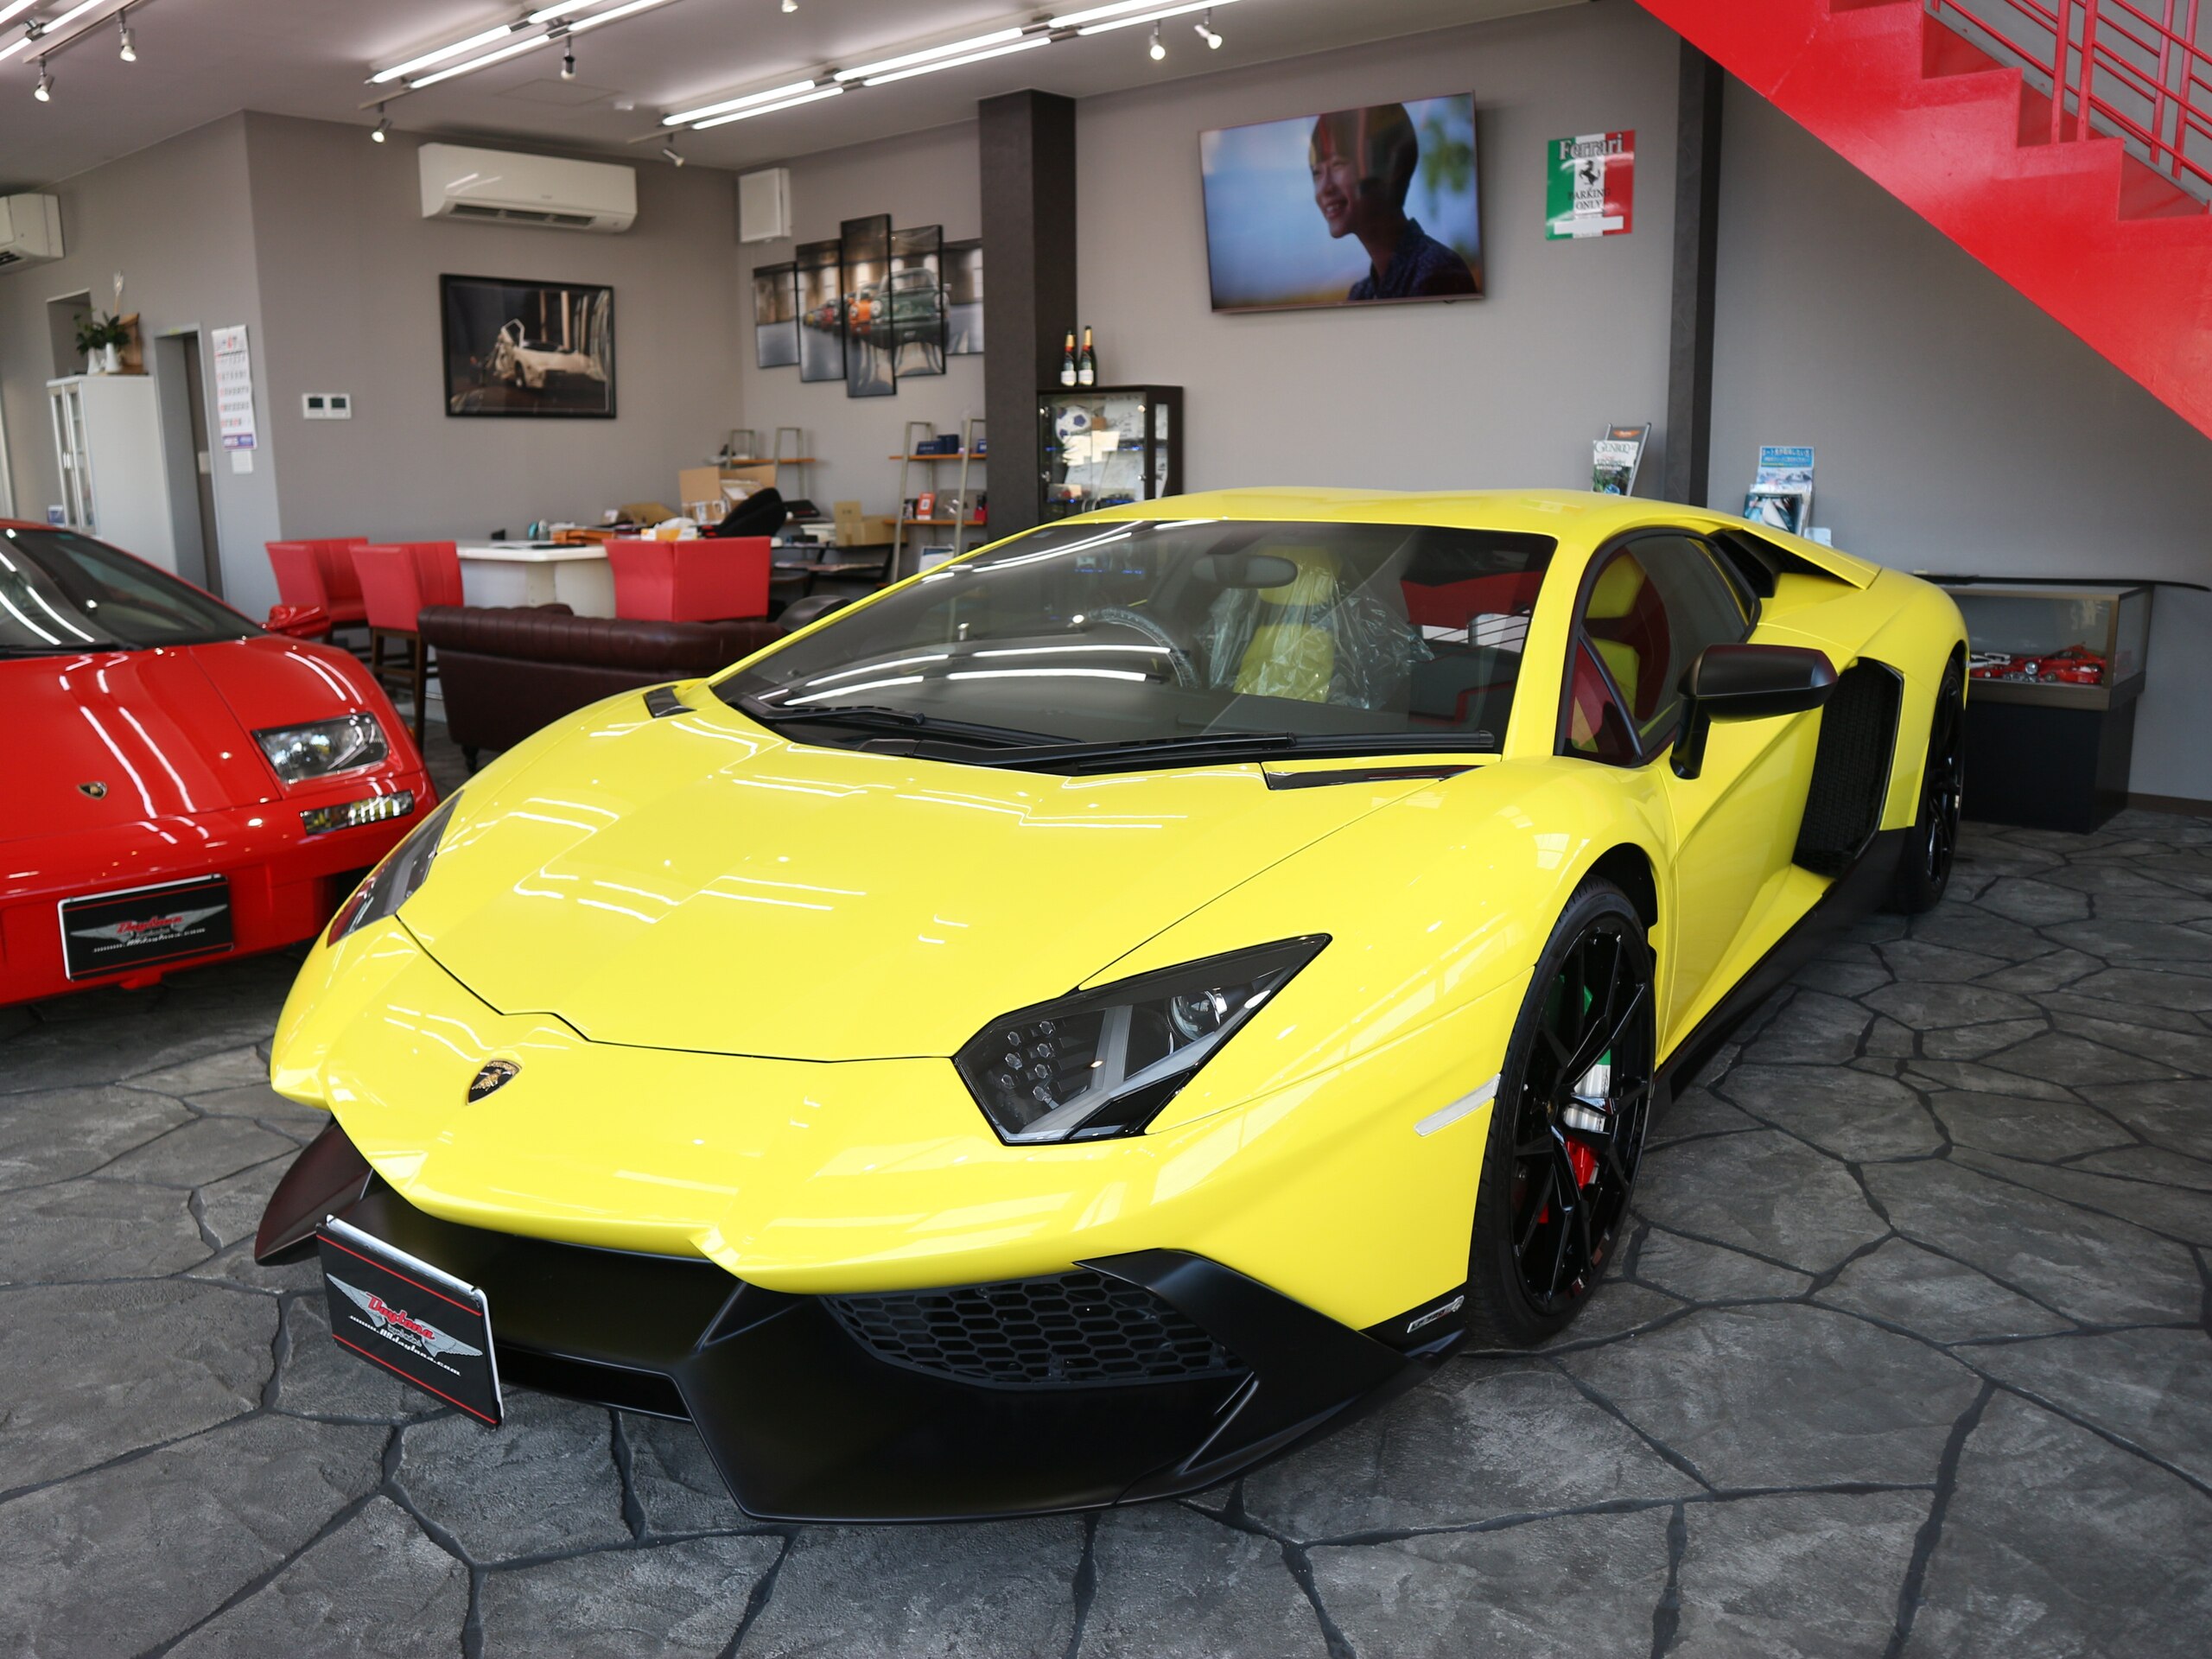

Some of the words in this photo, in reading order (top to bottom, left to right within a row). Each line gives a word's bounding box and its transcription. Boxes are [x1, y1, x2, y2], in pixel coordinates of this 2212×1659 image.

[1559, 131, 1623, 160] Ferrari
[1568, 188, 1611, 200] PARKING
[1575, 200, 1602, 210] ONLY
[366, 1292, 435, 1340] Daytona
